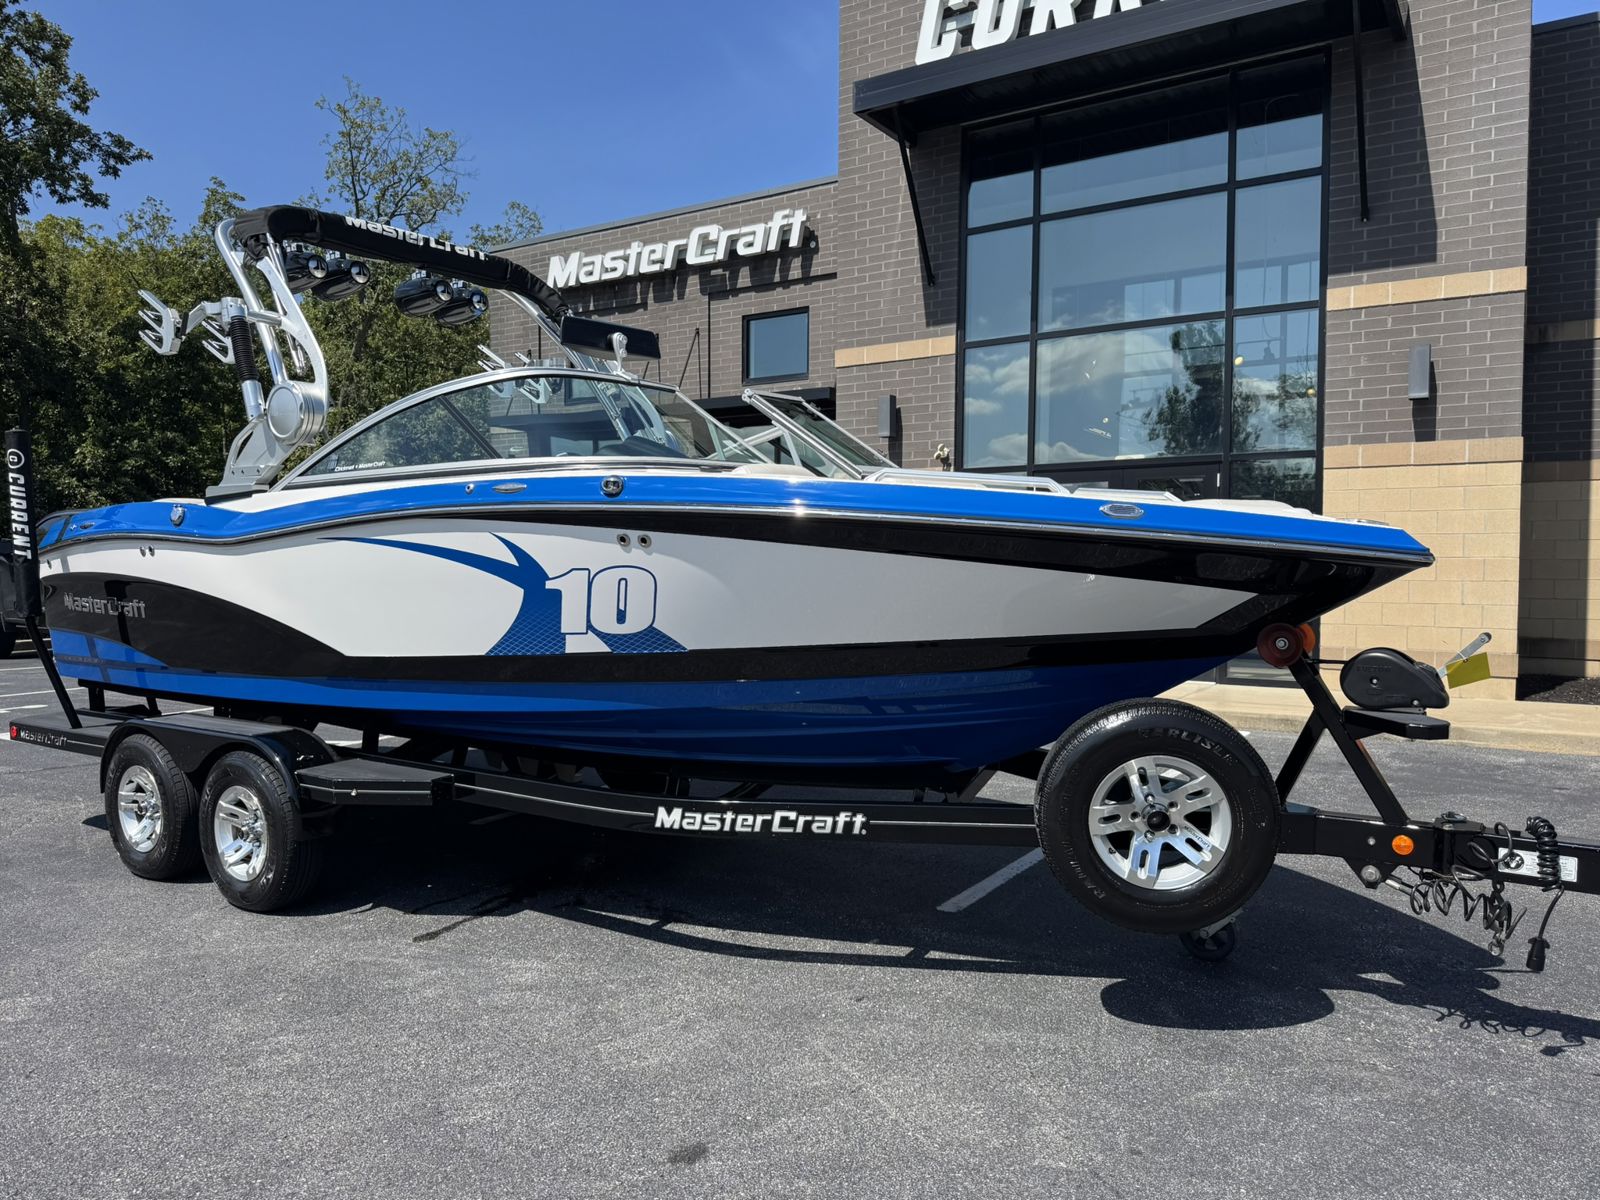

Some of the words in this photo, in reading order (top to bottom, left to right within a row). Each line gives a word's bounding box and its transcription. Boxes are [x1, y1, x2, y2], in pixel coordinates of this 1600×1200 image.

[547, 208, 807, 289] MasterCraft
[8, 472, 32, 560] CURRENT
[64, 592, 146, 618] MasterCraft
[545, 565, 657, 635] 10
[655, 806, 867, 835] MasterCraft
